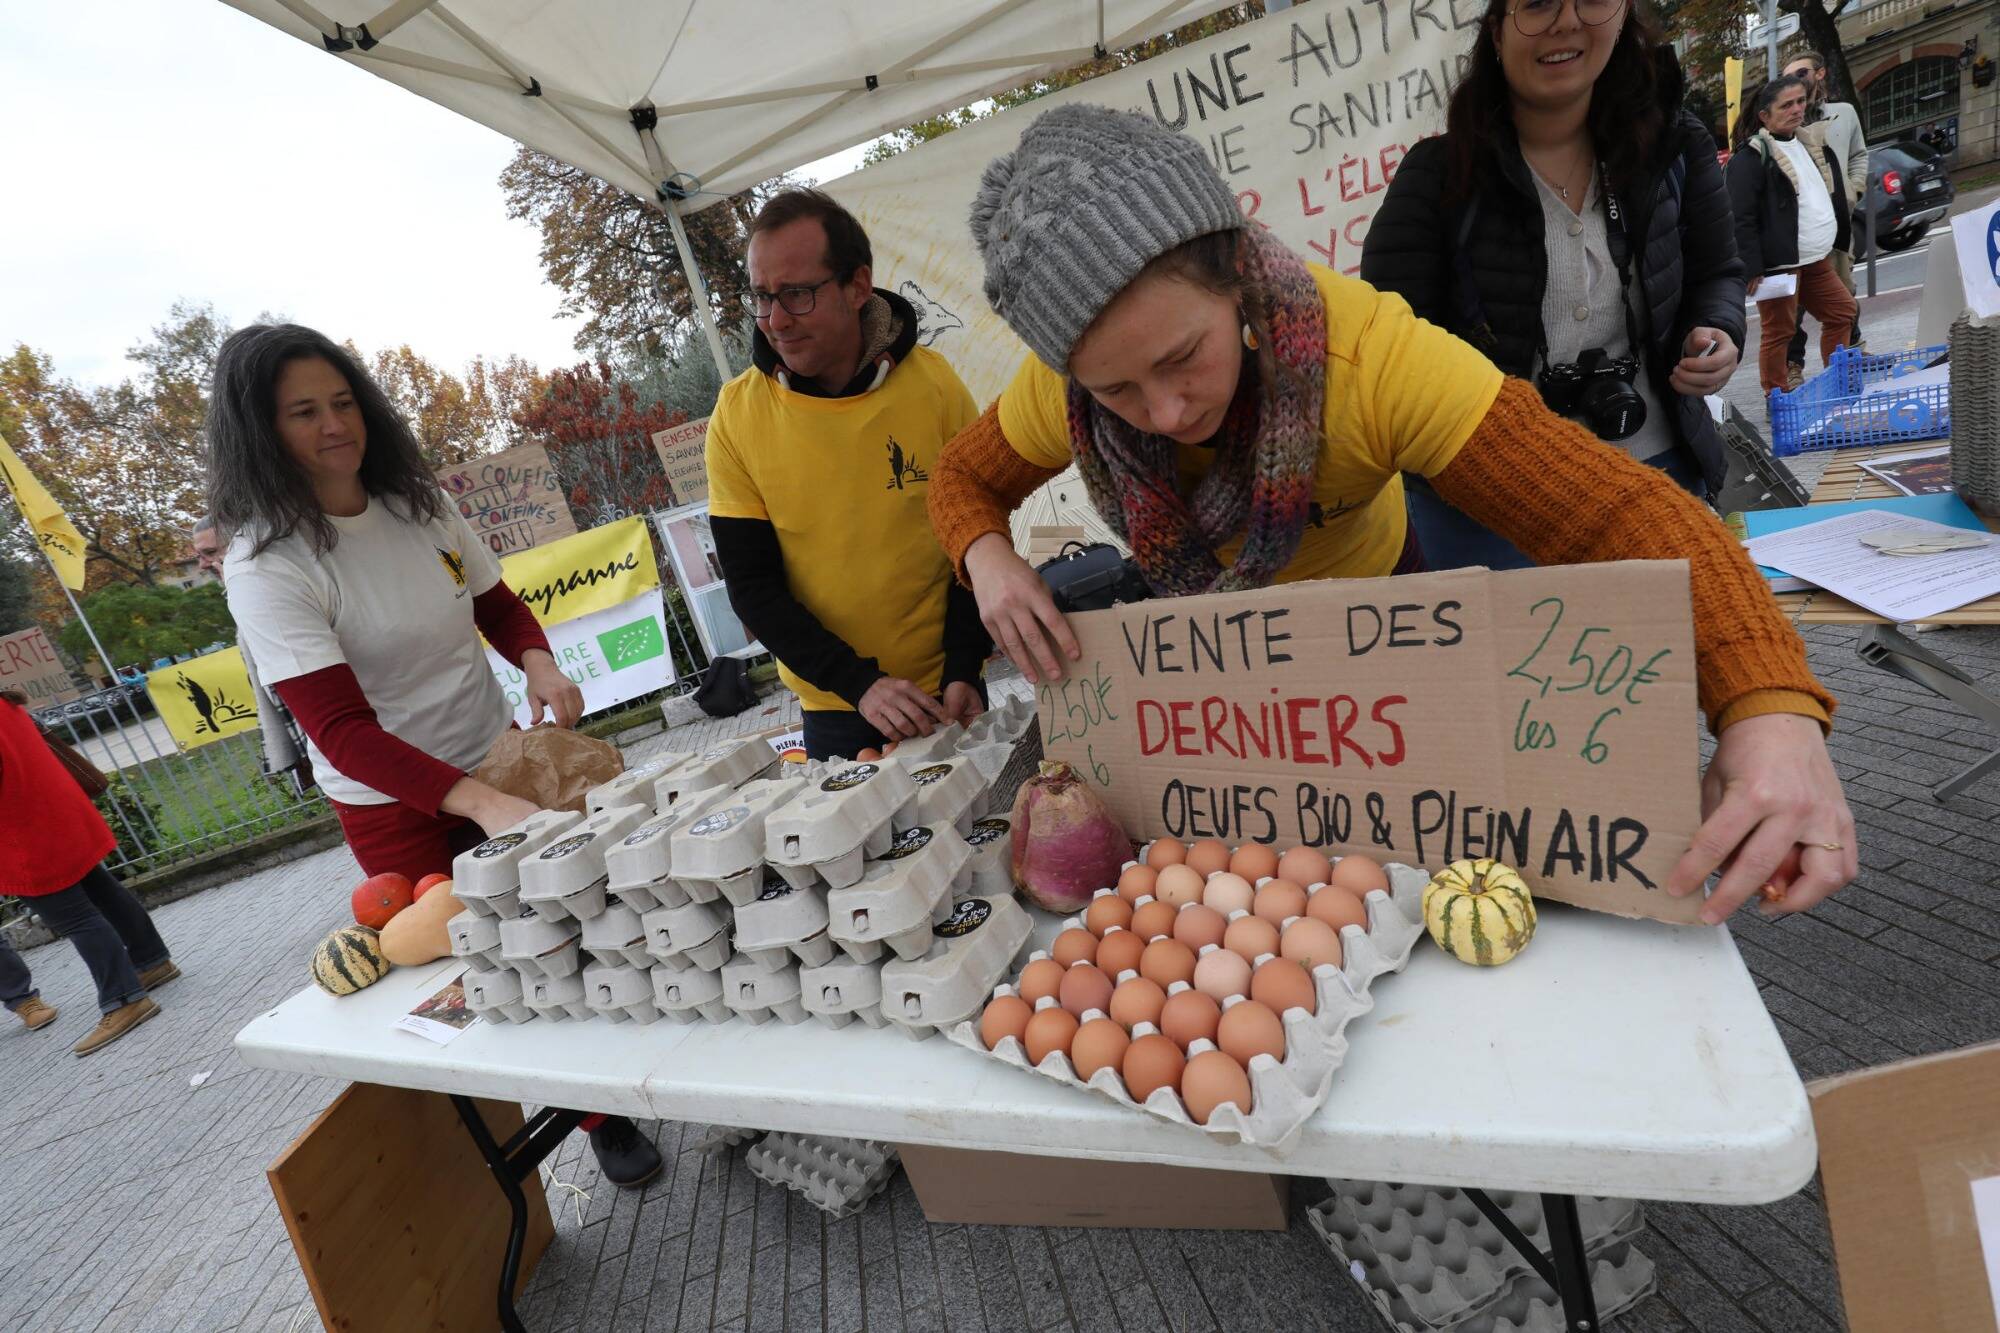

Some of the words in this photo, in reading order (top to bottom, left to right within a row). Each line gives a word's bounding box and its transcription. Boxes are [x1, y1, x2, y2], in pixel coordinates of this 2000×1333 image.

[1147, 43, 1265, 132] UNE
[481, 520, 532, 553] ON!
[508, 551, 639, 616] aysanne
[1122, 608, 1294, 678] VENTE
[1347, 600, 1463, 657] DES
[1507, 597, 1672, 705] 2,50€
[1041, 661, 1118, 746] 2,50€
[1514, 699, 1556, 752] les
[1580, 707, 1622, 764] 6
[1087, 744, 1110, 787] 6
[1161, 778, 1278, 845] OEUFS
[1365, 791, 1395, 850] &
[1542, 808, 1658, 890] AIR
